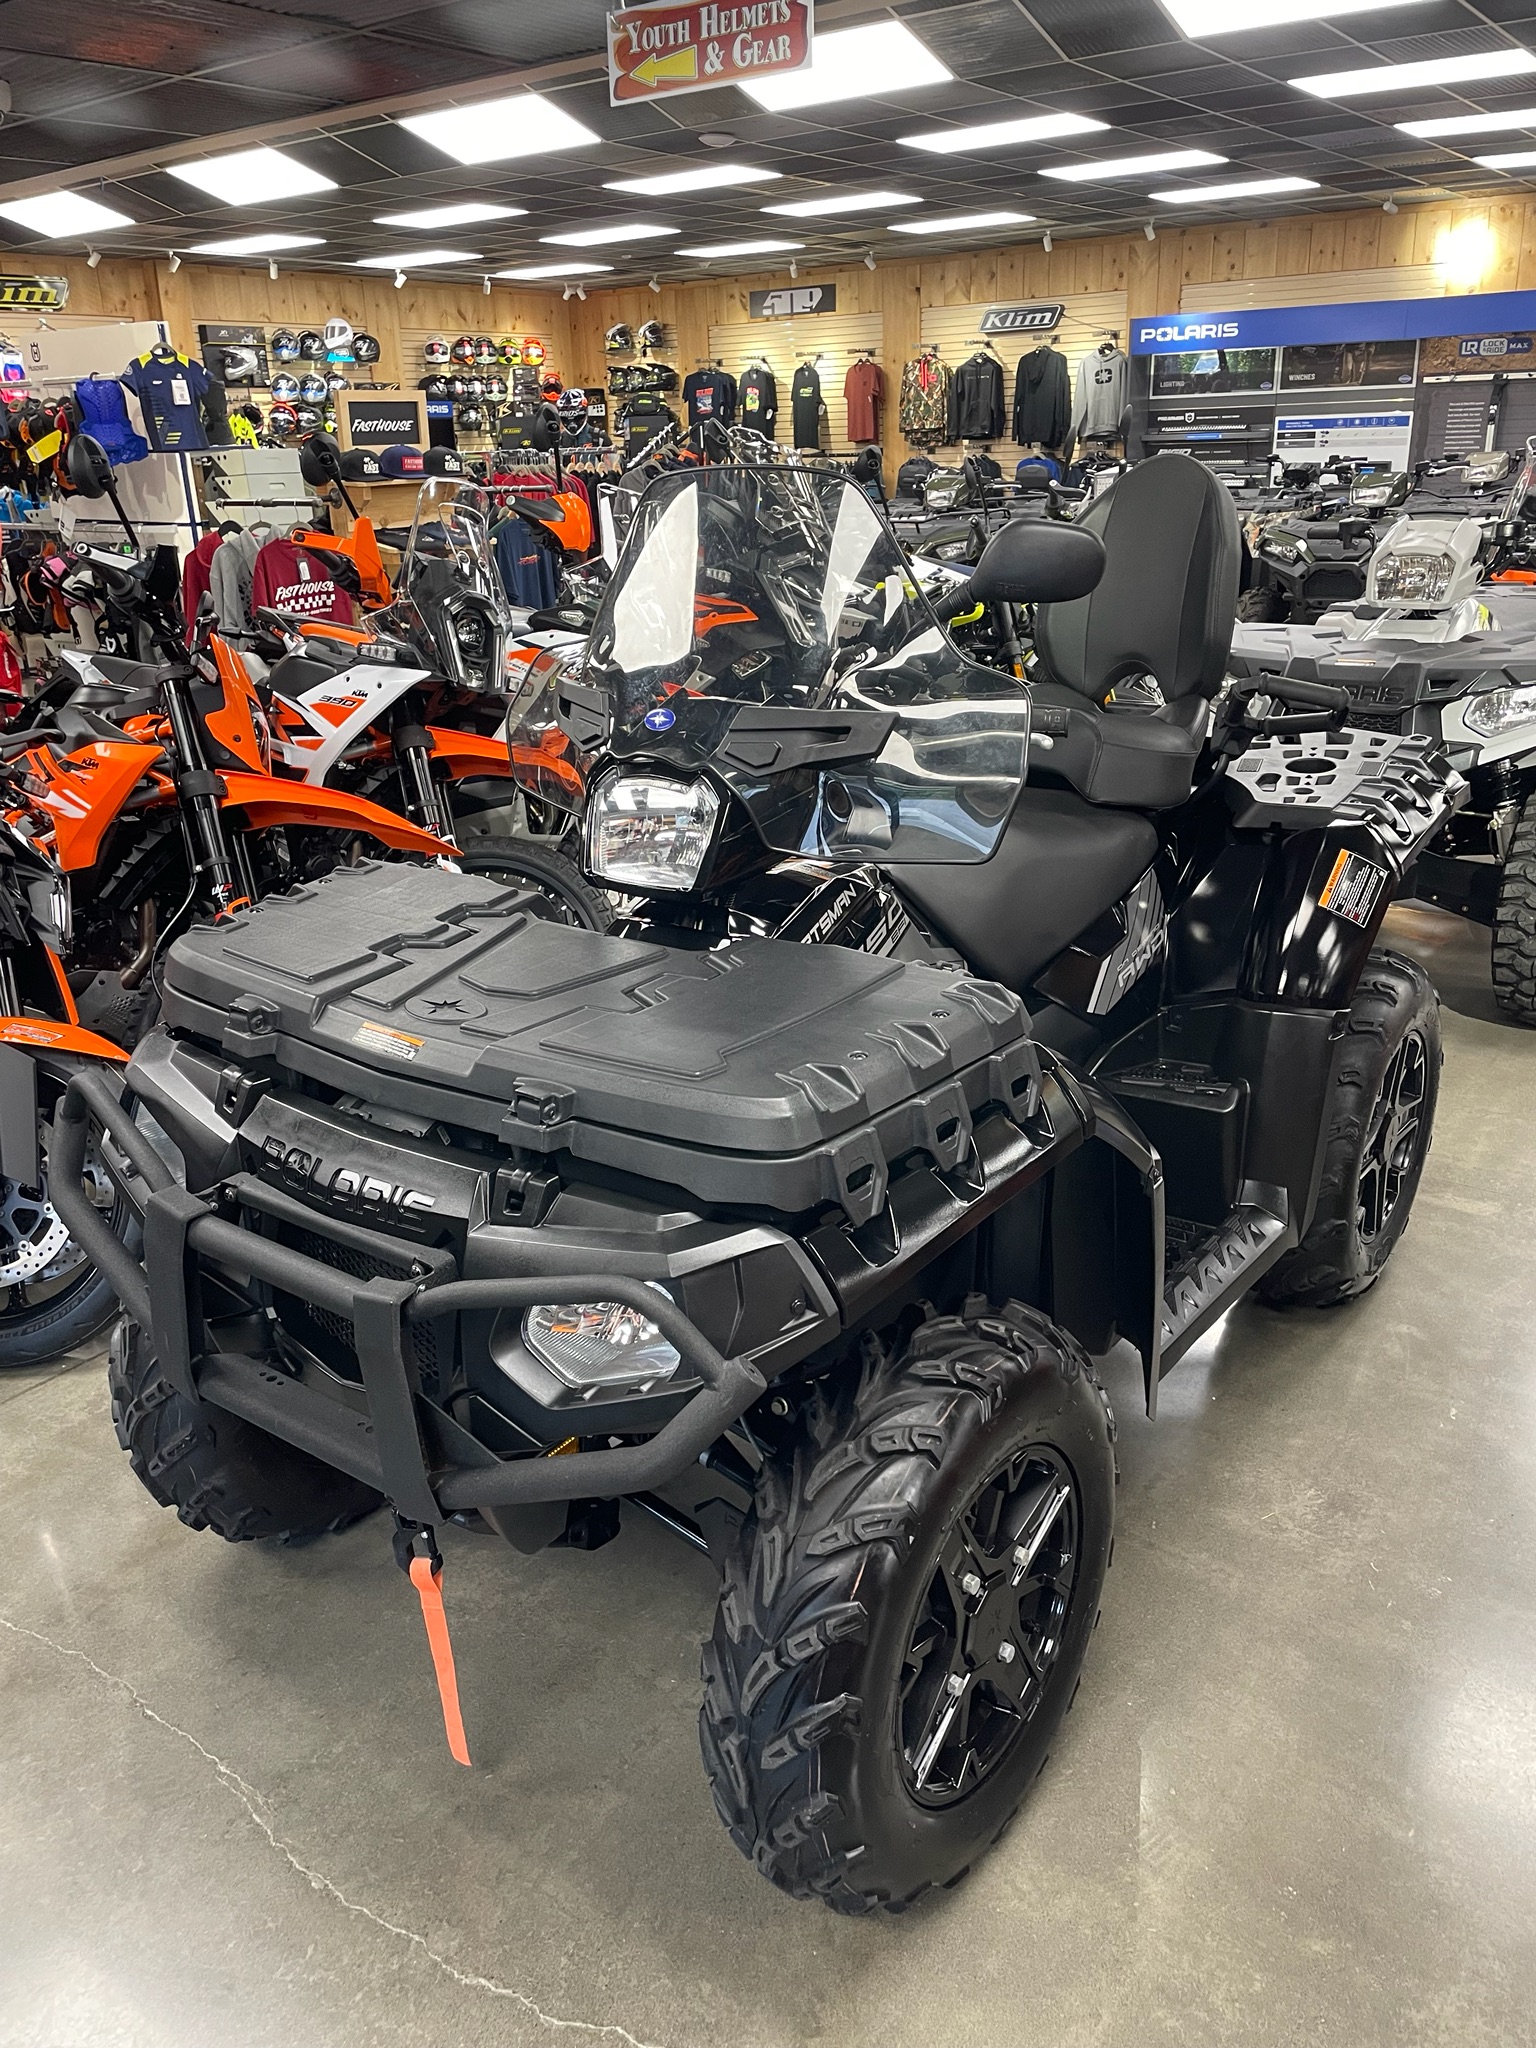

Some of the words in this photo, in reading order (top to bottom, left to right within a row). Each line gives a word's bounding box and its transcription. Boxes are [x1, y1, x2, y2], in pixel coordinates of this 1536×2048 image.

[626, 19, 691, 55] YOUTH
[699, 0, 792, 40] HELMETS
[703, 40, 725, 77] &
[732, 31, 792, 70] GEAR
[0, 282, 58, 304] im
[762, 287, 823, 315] 509
[1140, 322, 1239, 343] POLARIS
[1483, 339, 1505, 347] LOCK
[1288, 373, 1316, 381] WINCHES
[351, 418, 414, 433] FASTHOUSE
[275, 580, 335, 602] FASTHOUSE
[80, 756, 100, 770] KTM
[1118, 928, 1165, 988] AWD
[260, 1134, 437, 1234] POLARIS
